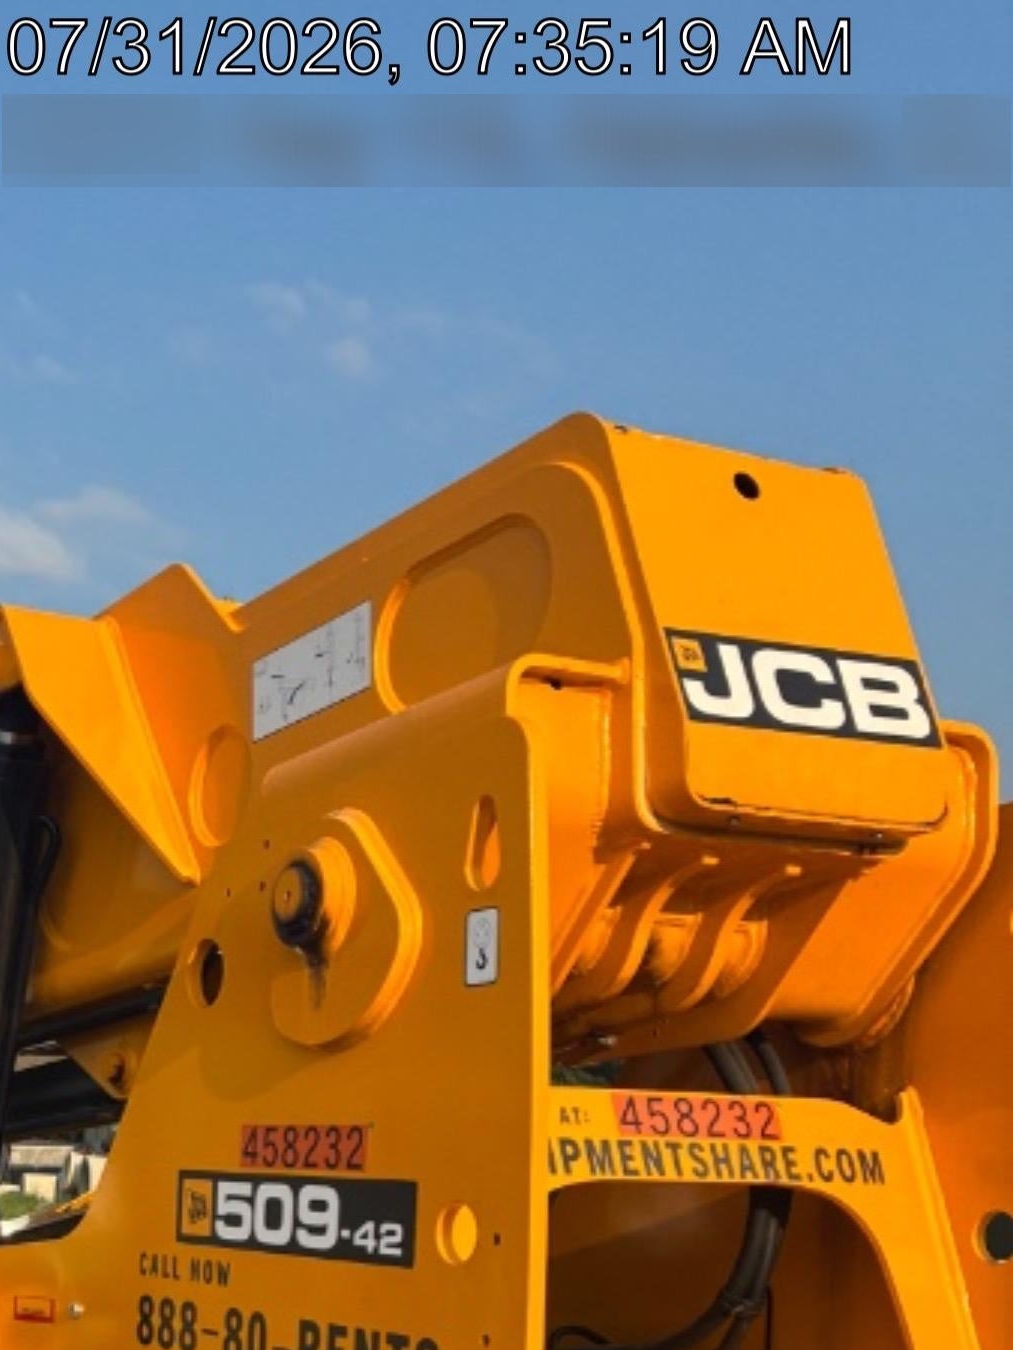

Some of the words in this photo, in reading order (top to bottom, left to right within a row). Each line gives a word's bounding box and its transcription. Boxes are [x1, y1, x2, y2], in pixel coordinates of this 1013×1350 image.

[682, 642, 931, 739] JCB
[619, 1095, 781, 1141] 458232
[241, 1125, 365, 1171] 458232
[140, 1252, 181, 1282] CALL
[190, 1259, 231, 1288] NOW
